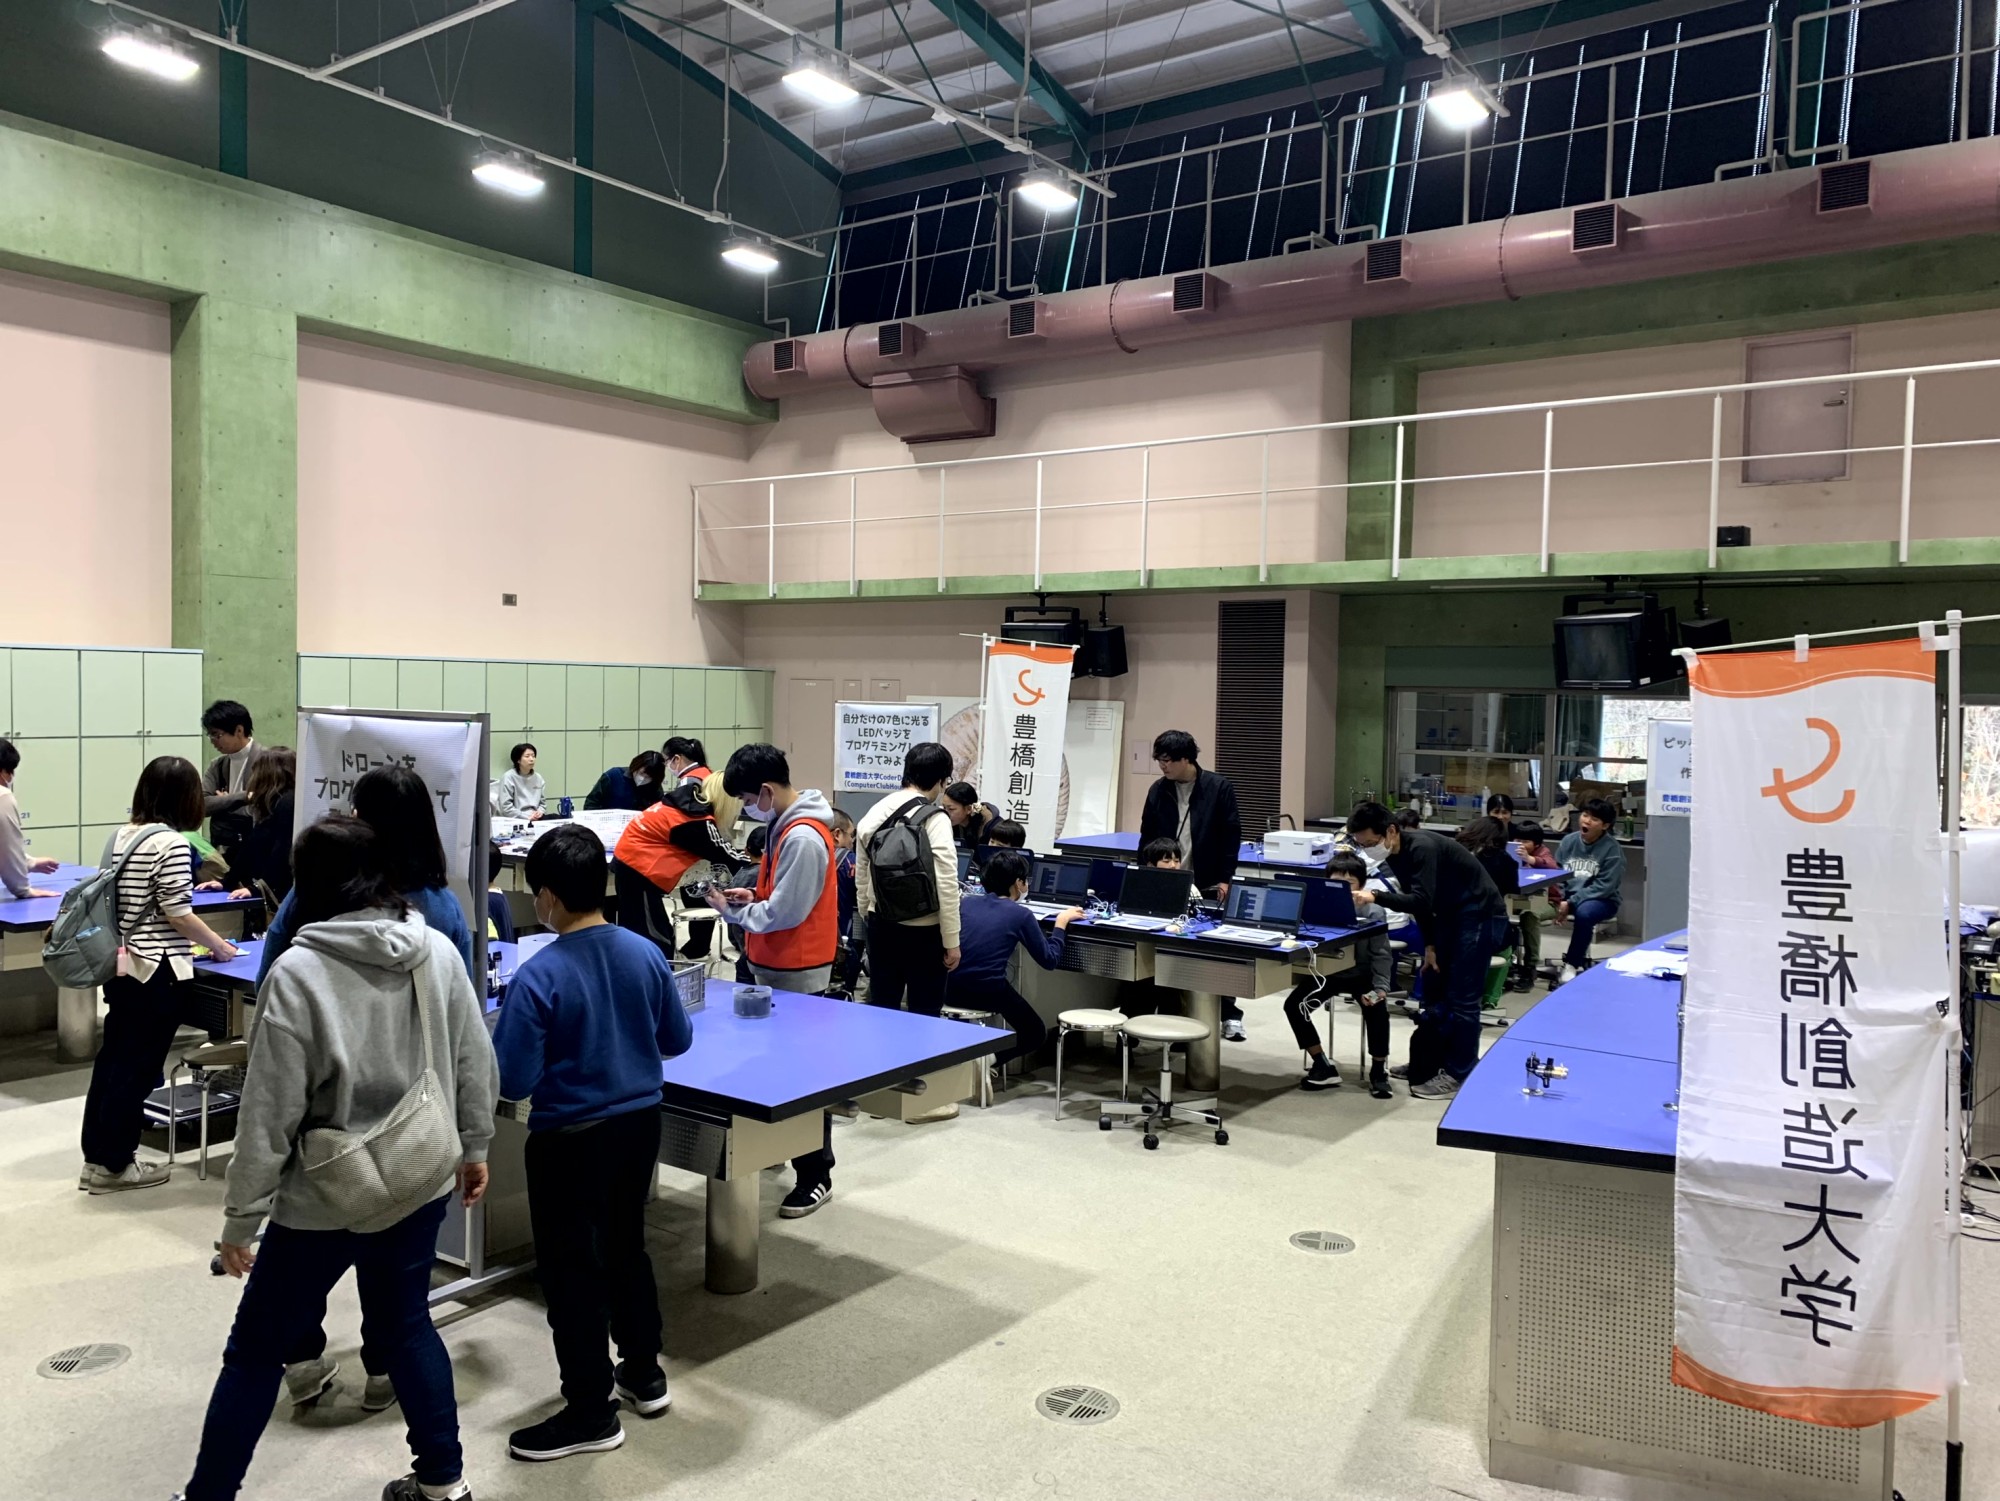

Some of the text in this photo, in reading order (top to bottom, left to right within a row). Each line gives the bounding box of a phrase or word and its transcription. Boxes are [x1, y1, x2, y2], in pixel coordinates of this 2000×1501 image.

[843, 713, 929, 726] 自分だけの7色に光る
[858, 728, 911, 739] LEDバッジを
[1663, 737, 1692, 749] ピッ
[857, 754, 905, 766] 作ってみよ
[1005, 713, 1037, 825] 豊橋創造
[844, 780, 903, 790] (ComputerClubHou
